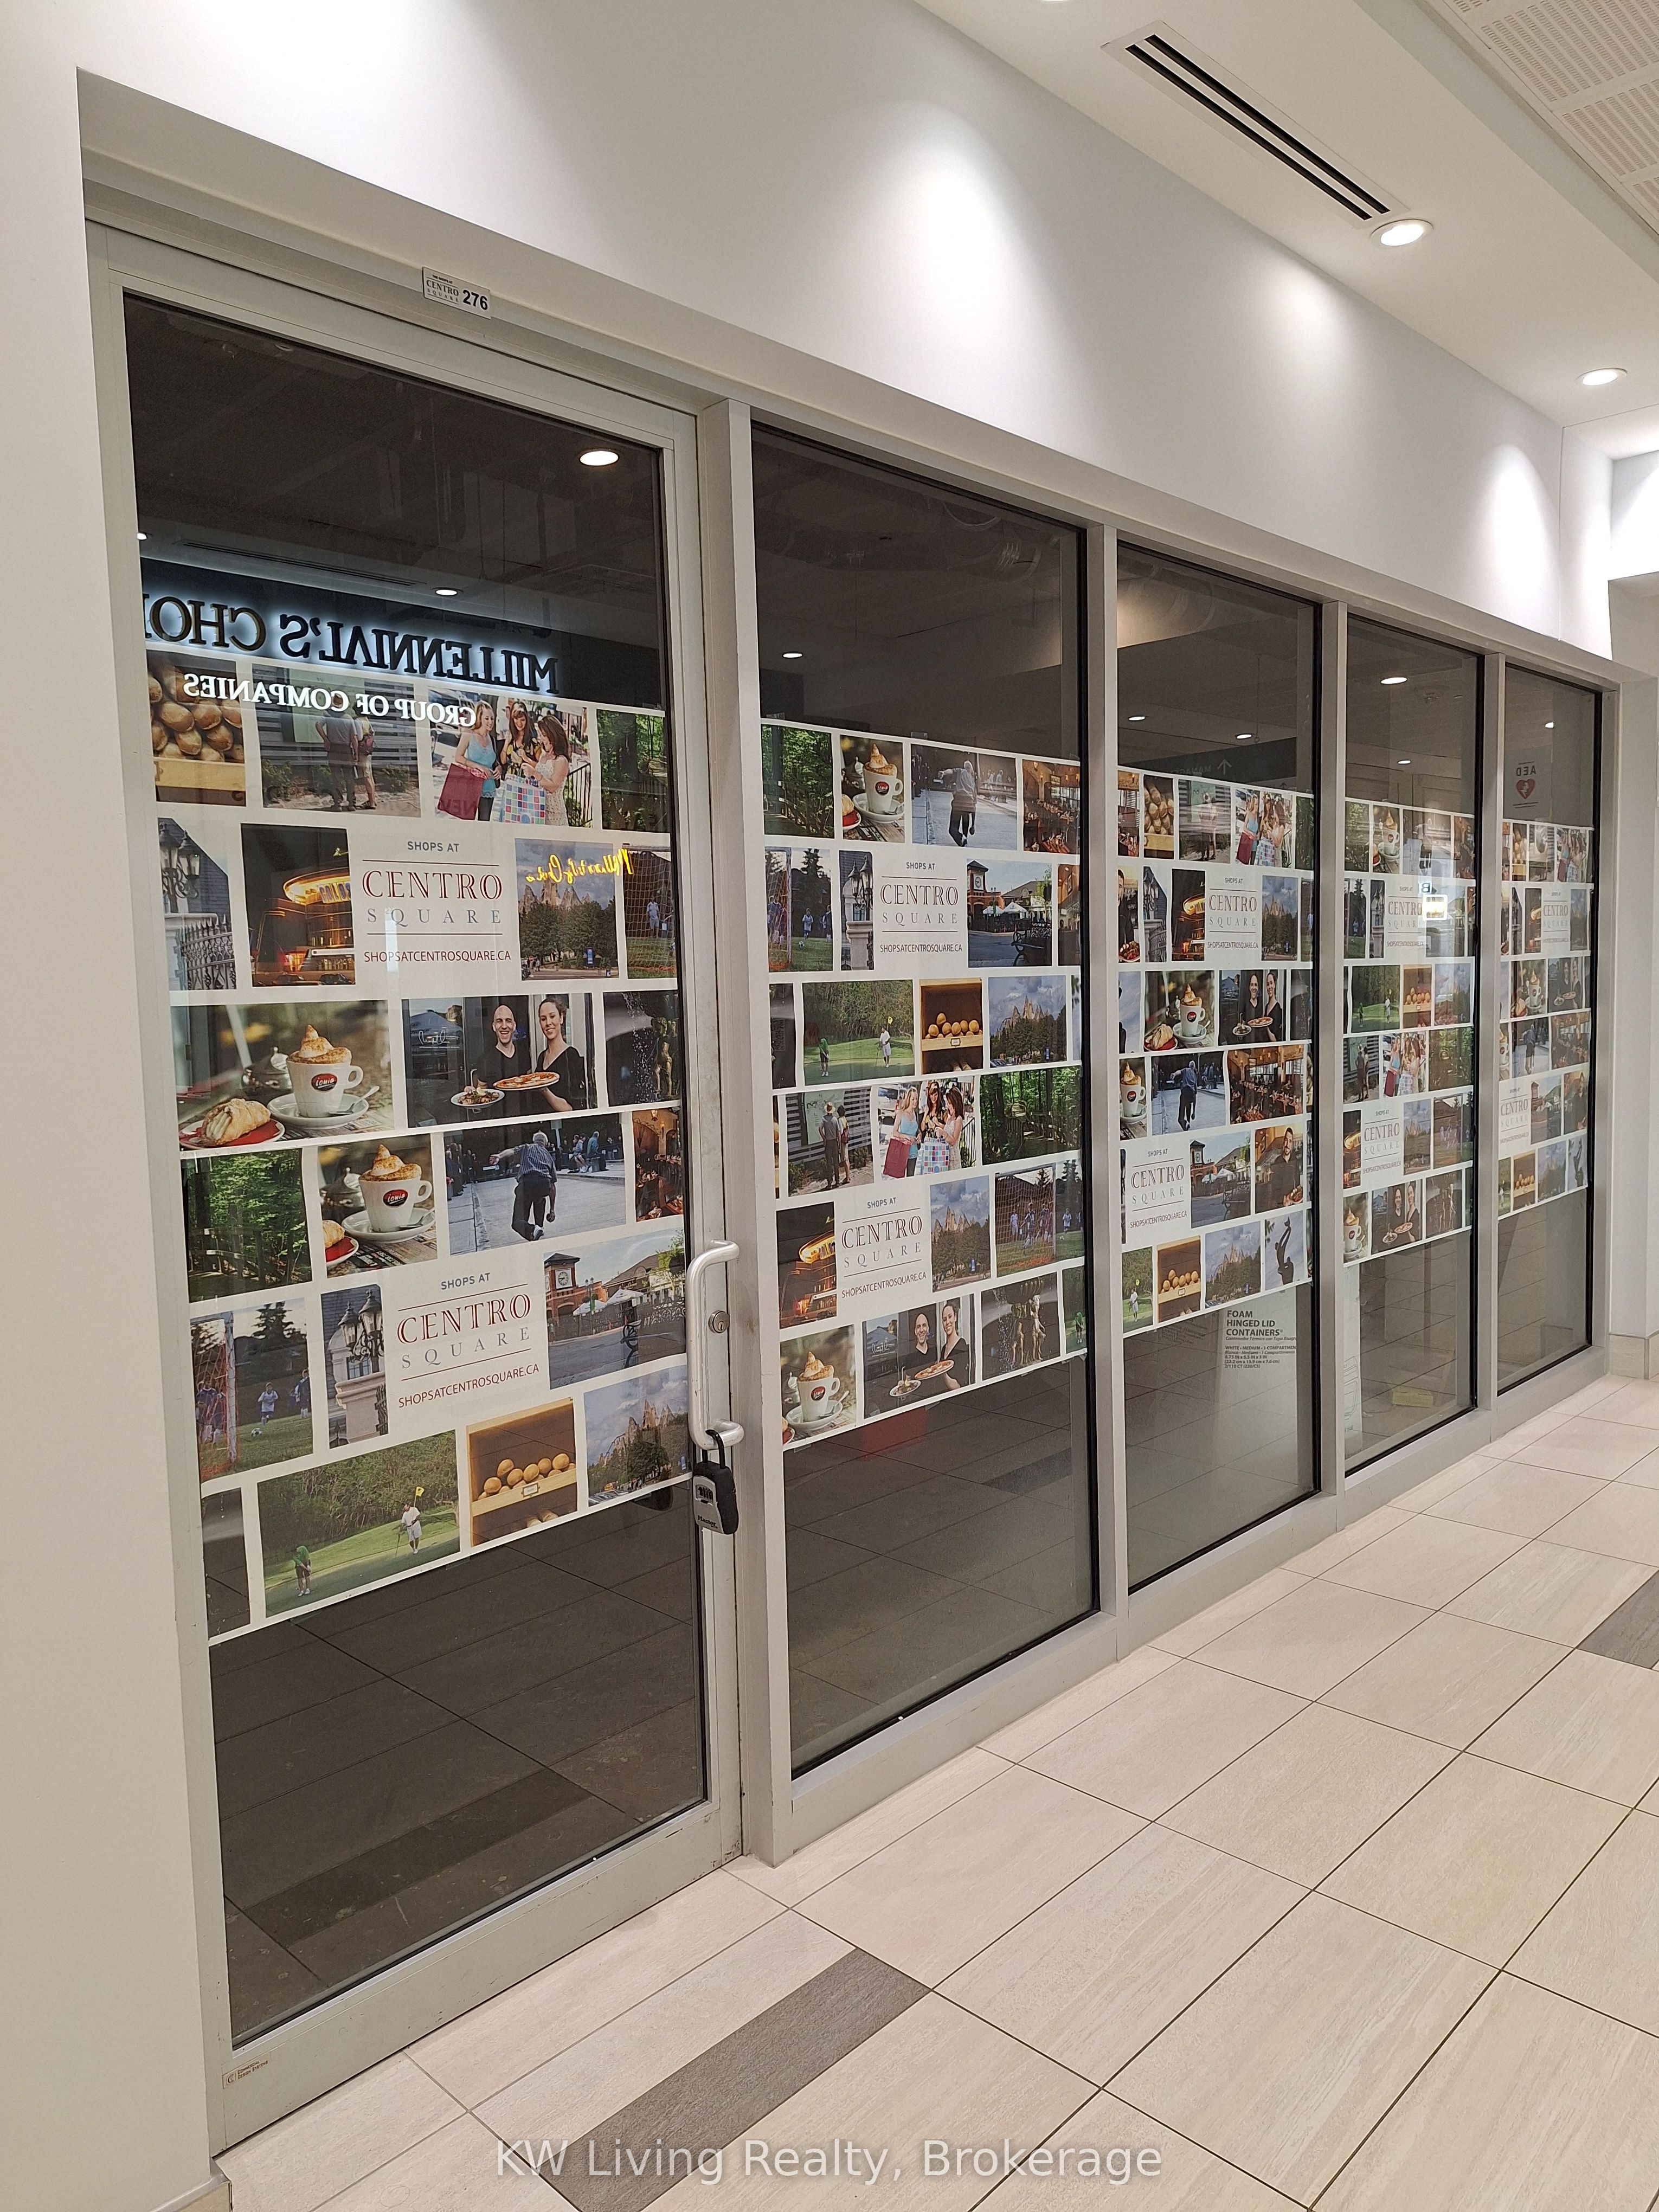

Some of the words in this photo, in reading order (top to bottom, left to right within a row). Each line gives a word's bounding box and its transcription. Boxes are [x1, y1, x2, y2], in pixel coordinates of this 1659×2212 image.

[426, 279, 459, 297] CENTRO
[427, 288, 459, 303] SQUARE
[462, 290, 488, 310] 276
[407, 841, 443, 852] SHOPS
[447, 843, 459, 853] AT
[906, 861, 927, 870] SHOPS
[362, 870, 503, 901] CENTRO
[880, 884, 959, 905] CENTRO
[1208, 895, 1257, 912] CENTRO
[1543, 904, 1568, 916] CENTRO
[367, 908, 501, 927] SQUARE
[882, 912, 957, 927] SQUARE
[1210, 917, 1256, 928] SQUARE
[364, 950, 511, 963] SHOPSATCENTROSQUARE.CA
[880, 943, 962, 953] SHOPSATCENTROSQUARE.CA
[1500, 1098, 1528, 1116] CENTRO
[1364, 1123, 1400, 1142] CENTRO
[1364, 1140, 1399, 1155] SQUARE
[1131, 1164, 1185, 1188] CENTRO
[867, 1199, 888, 1209] SHOPS
[1131, 1186, 1184, 1204] SQUARE
[841, 1215, 923, 1249] CENTRO
[844, 1242, 921, 1269] SQUARE
[440, 1275, 475, 1290] SHOPS
[477, 1272, 491, 1283] AT
[841, 1271, 927, 1298] SHOPSATCENTROSQUARE.CA
[396, 1293, 531, 1345] CENTRO
[401, 1327, 530, 1369] SQUARE
[398, 1364, 539, 1408] SHOPSATCENTROSQUARE.CA
